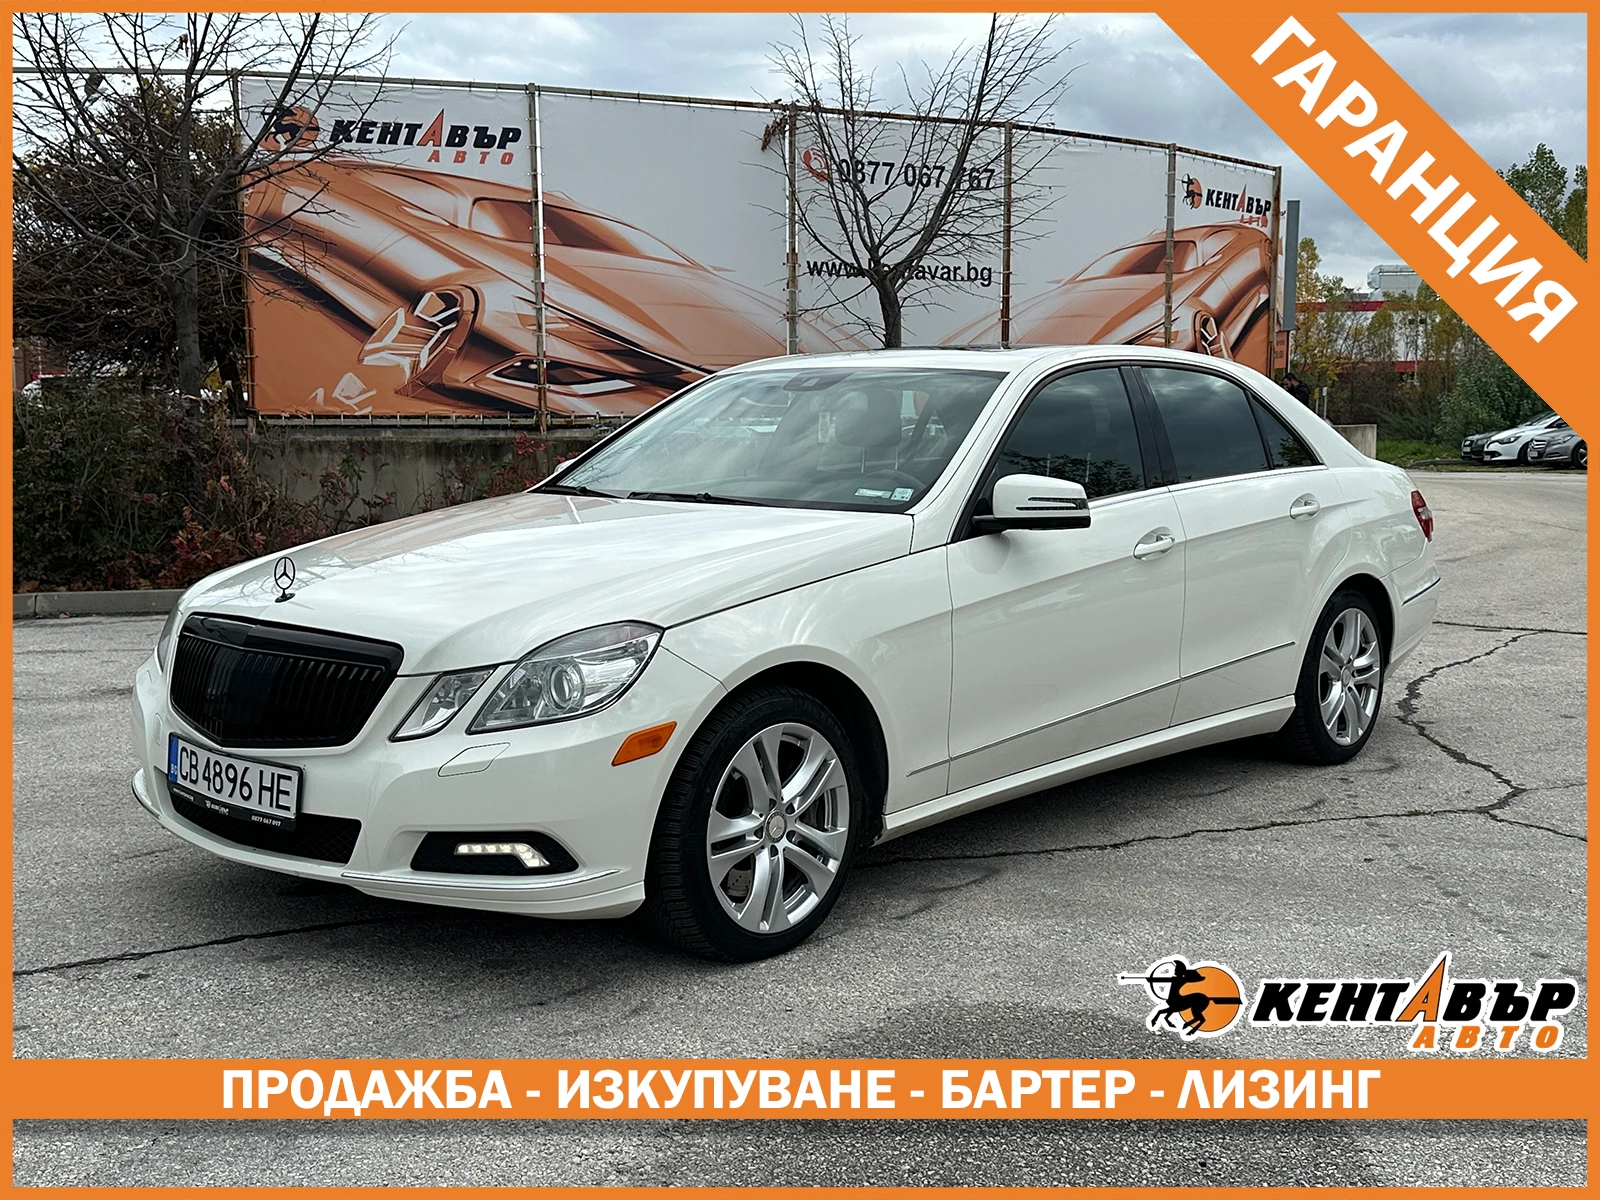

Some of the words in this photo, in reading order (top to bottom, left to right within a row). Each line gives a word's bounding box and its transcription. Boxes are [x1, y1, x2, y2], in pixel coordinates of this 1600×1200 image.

[329, 108, 522, 149] КЕНТАВЪР
[427, 150, 514, 164] АВТО
[838, 159, 895, 186] 0877
[904, 163, 946, 189] 067
[1205, 184, 1272, 216] КЕНТАВЪР
[202, 756, 253, 802] 4896
